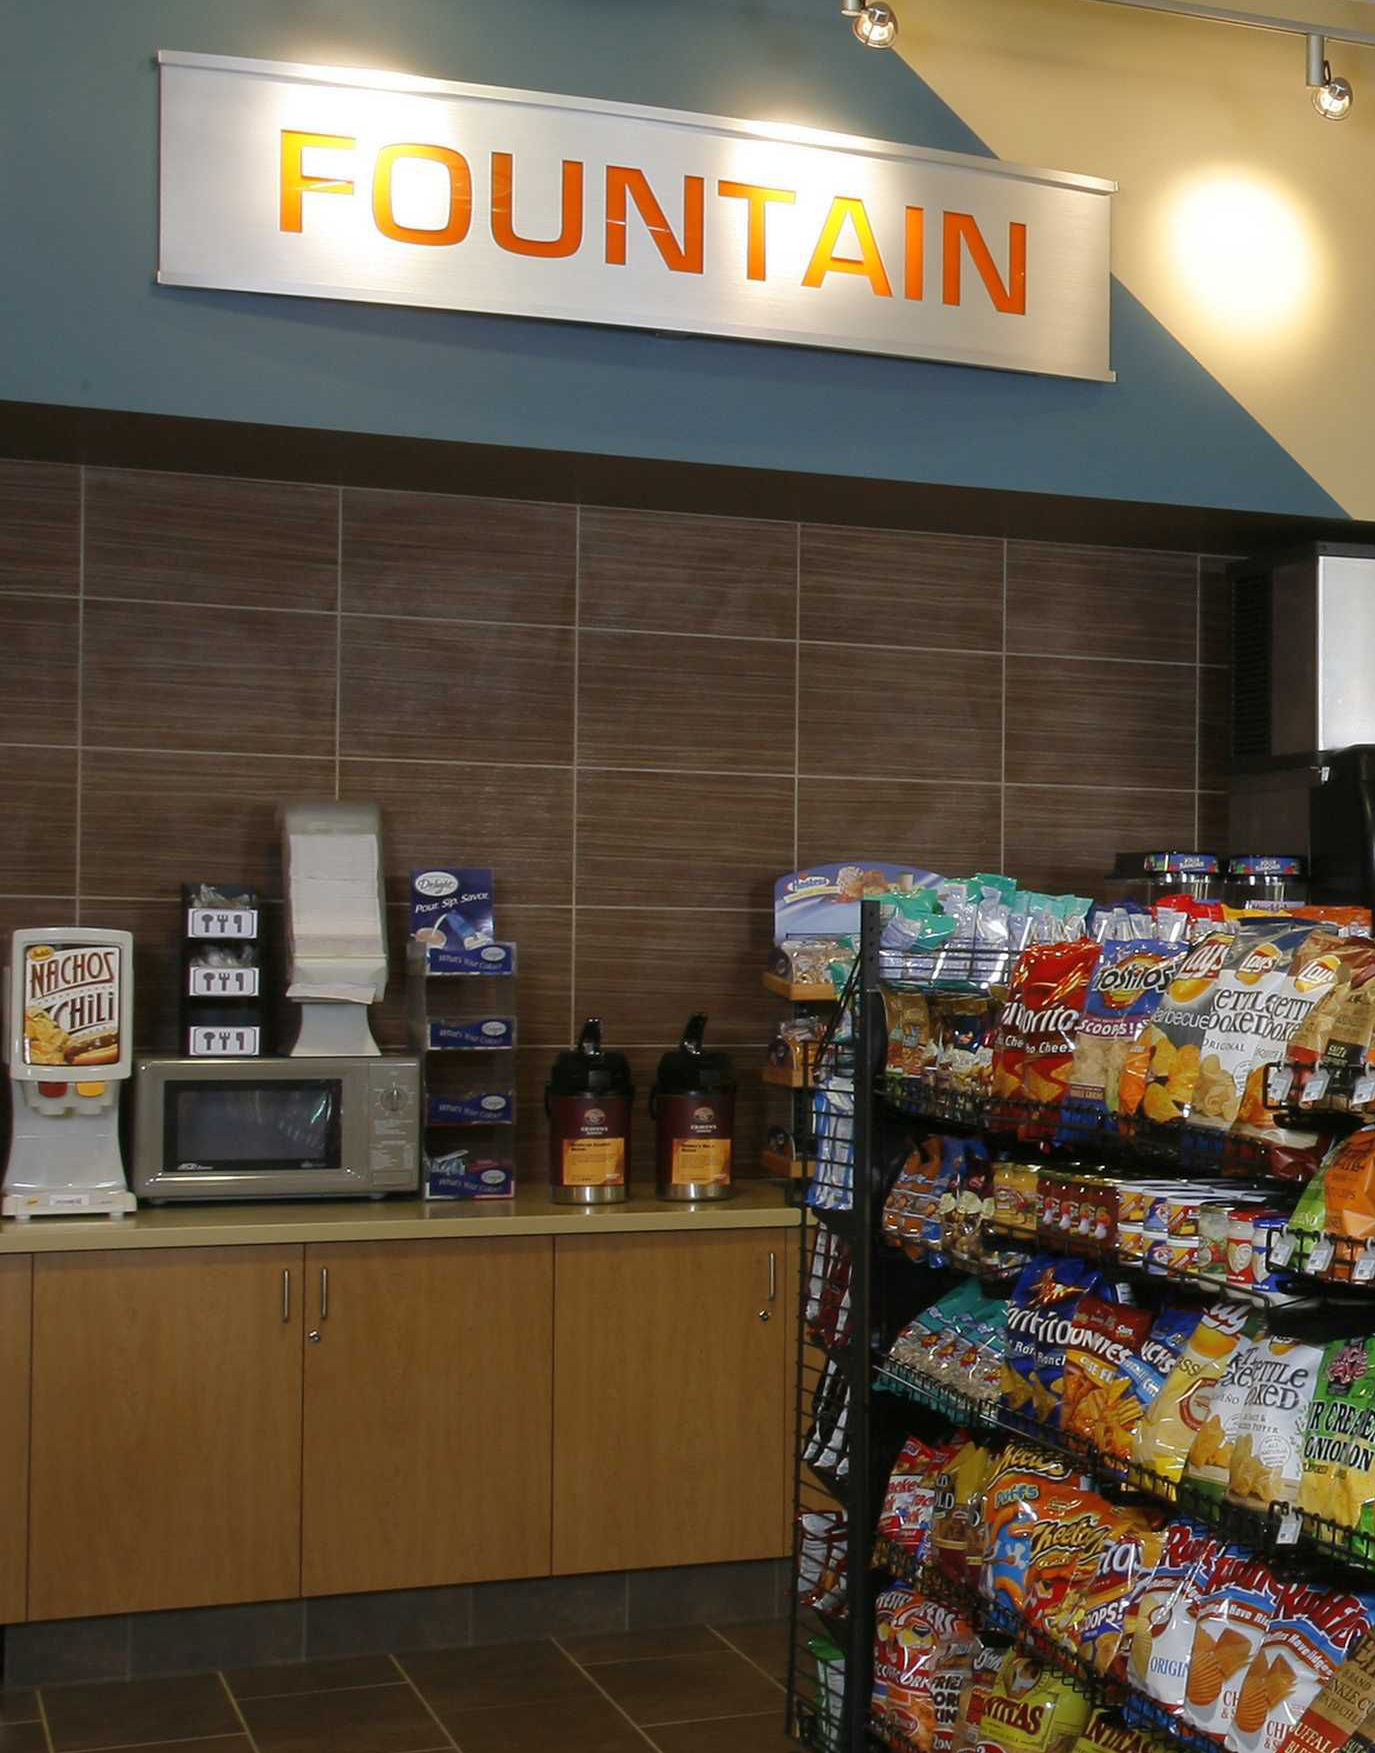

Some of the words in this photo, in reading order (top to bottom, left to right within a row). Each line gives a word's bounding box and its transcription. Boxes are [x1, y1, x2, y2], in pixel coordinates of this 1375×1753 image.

[279, 129, 1027, 315] FOUNTAIN
[29, 949, 116, 998] NACHOS
[1080, 1019, 1134, 1036] SCOOPS!
